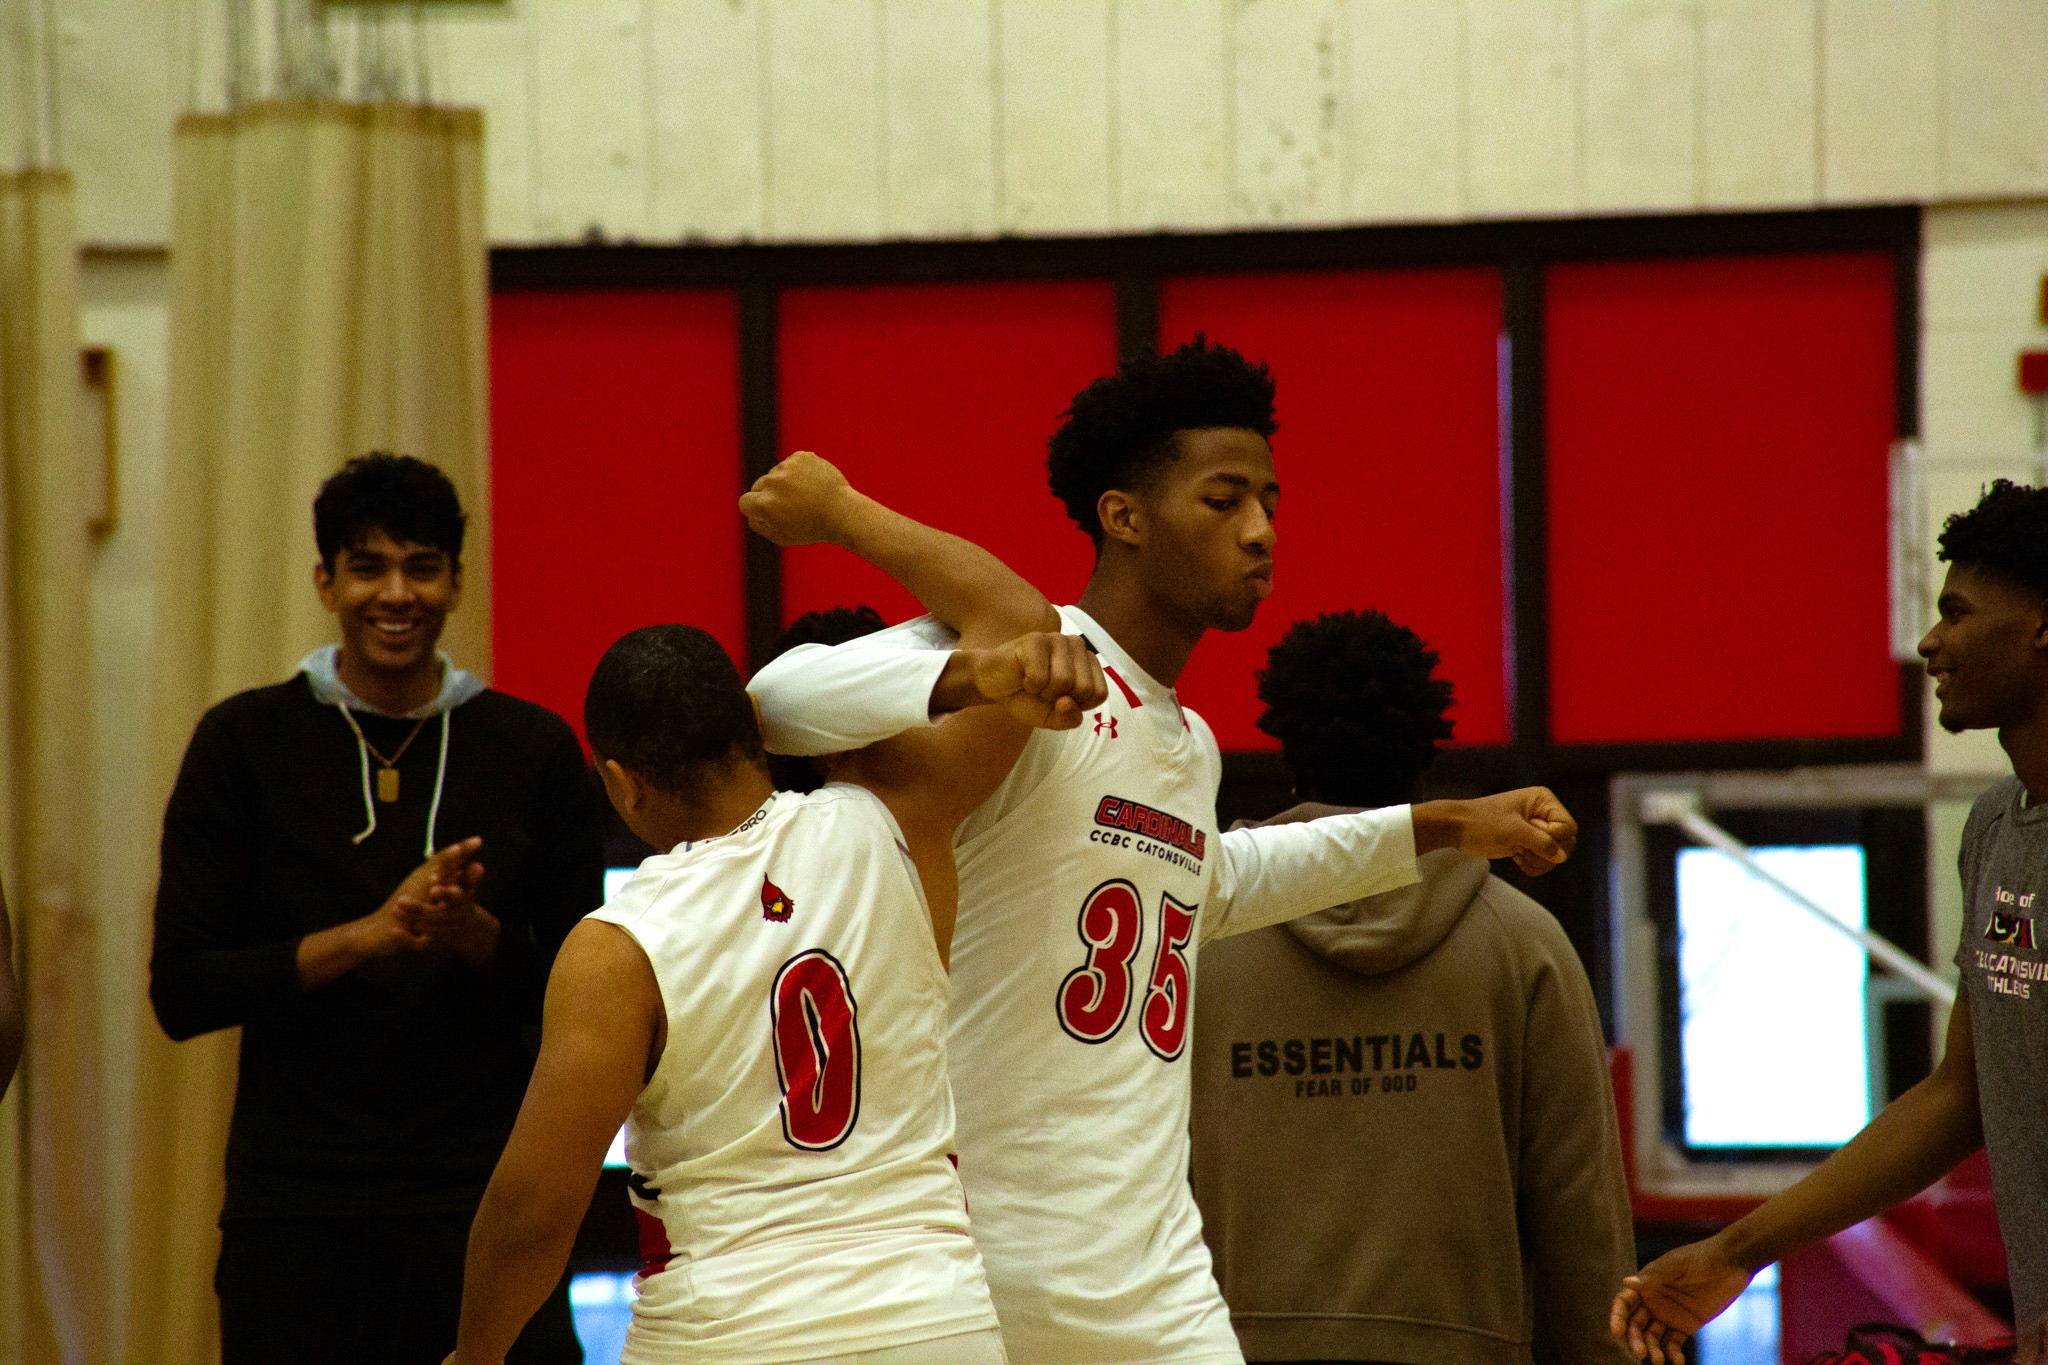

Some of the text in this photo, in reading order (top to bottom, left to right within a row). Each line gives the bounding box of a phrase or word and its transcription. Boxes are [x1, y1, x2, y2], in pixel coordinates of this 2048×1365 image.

[1094, 795, 1206, 861] CARDINALS
[1090, 830, 1202, 876] CCBC CATONSVILLE
[2018, 893, 2036, 908] of
[1056, 878, 1198, 1062] 35
[770, 948, 861, 1151] 0
[1231, 1033, 1484, 1078] ESSENTIALS
[1295, 1073, 1418, 1098] FEAR OF GOD
